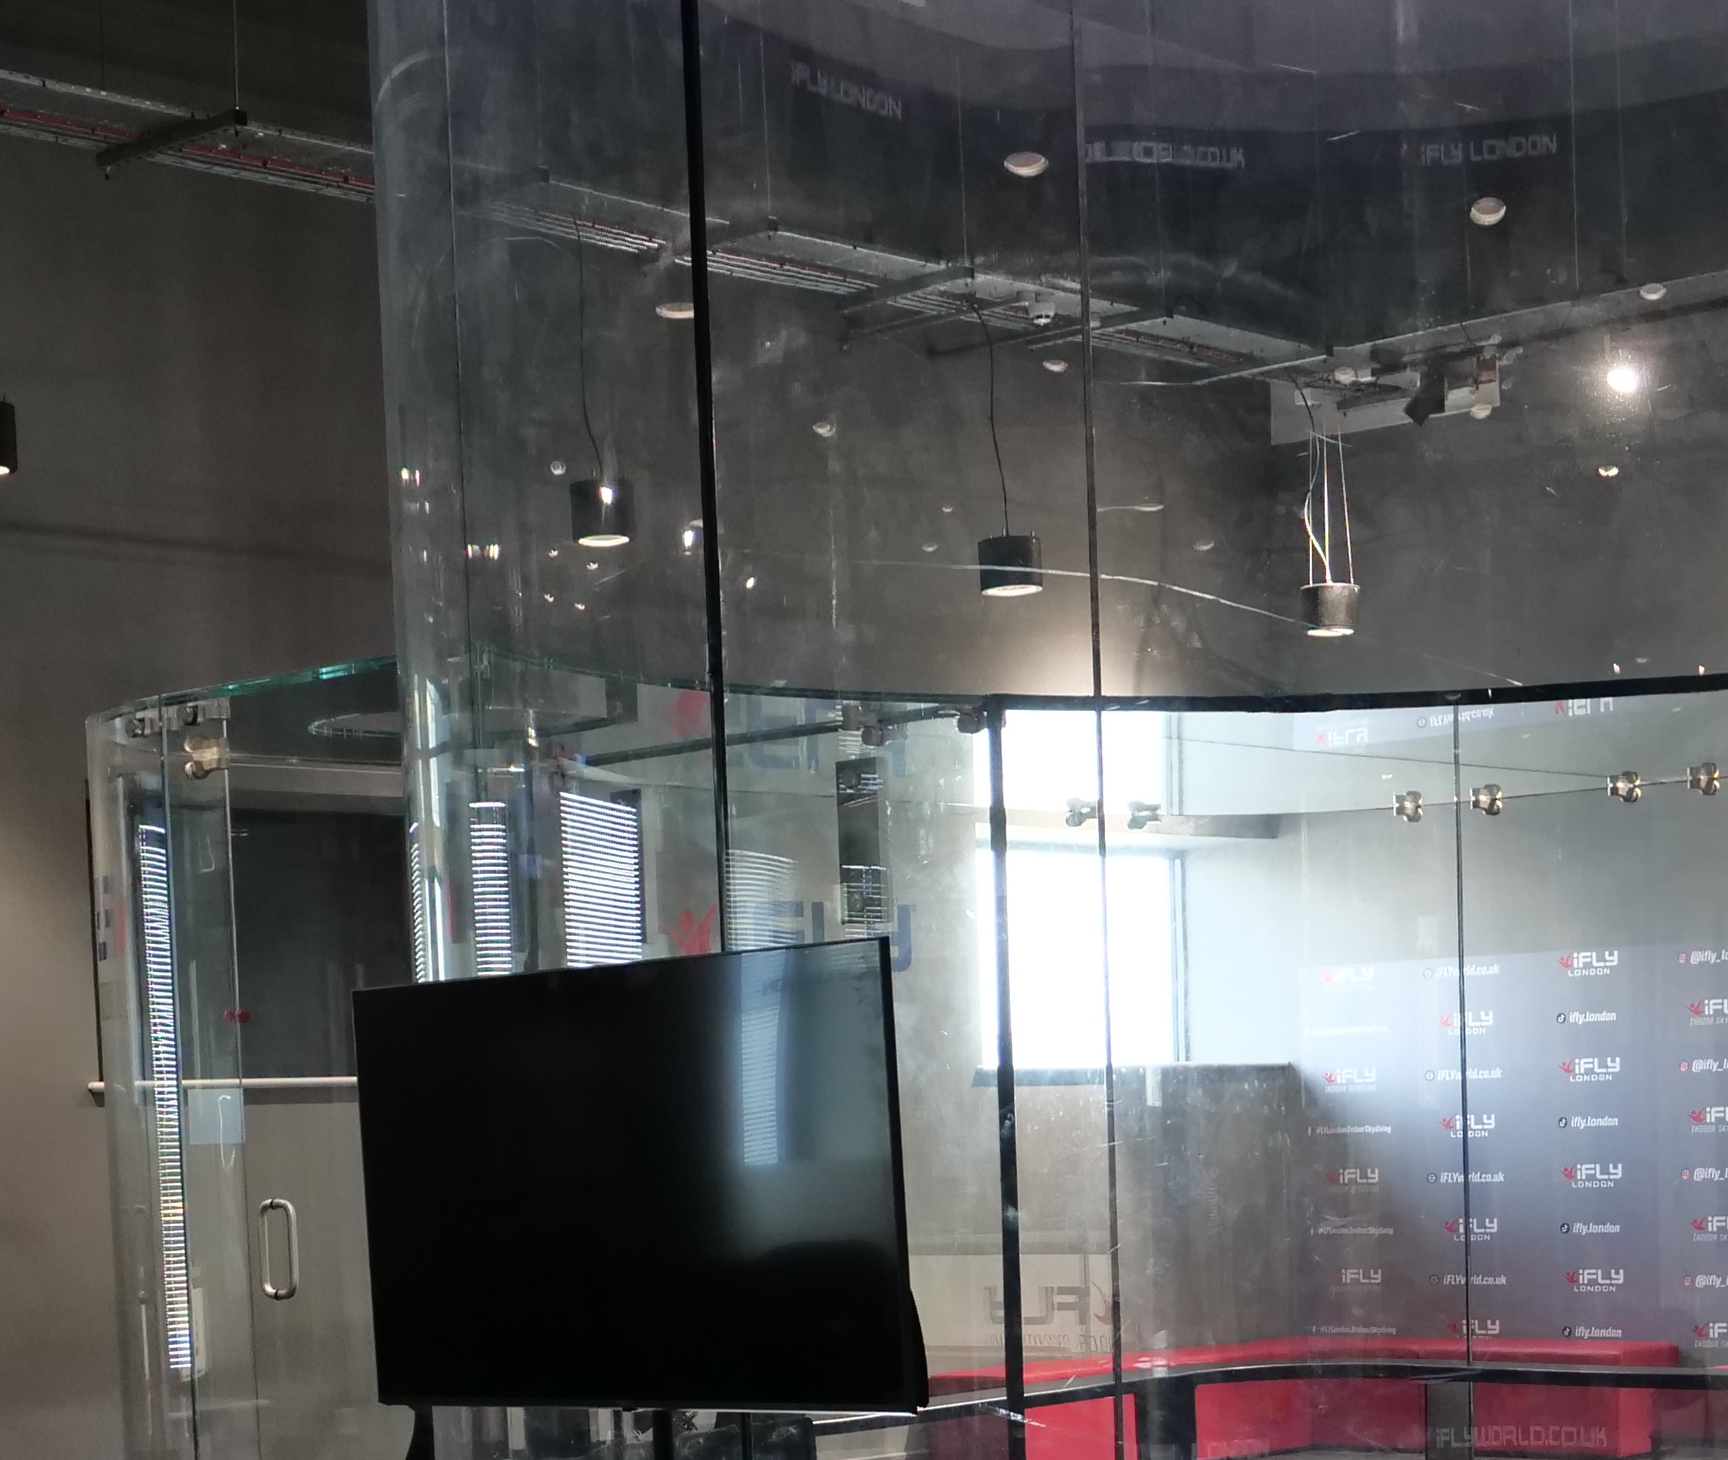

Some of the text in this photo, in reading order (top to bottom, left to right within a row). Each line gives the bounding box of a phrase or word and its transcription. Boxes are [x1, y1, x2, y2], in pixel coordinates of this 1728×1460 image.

[1573, 950, 1618, 968] iFLY
[1435, 964, 1500, 978] iFLYwrld.co.uk
[1568, 968, 1610, 977] LONDON
[1569, 1012, 1616, 1024] ifly.london
[1574, 1057, 1620, 1074] iFLY
[1336, 1068, 1376, 1084] iFLY
[1437, 1067, 1502, 1081] iFLYwrld.co.uk
[1570, 1074, 1612, 1082] LONDON
[1571, 1116, 1618, 1129] ifly.london
[1451, 1130, 1488, 1138] LODON
[1339, 1168, 1379, 1184] iFLY
[1440, 1171, 1504, 1184] iFLYwrld.co.uk
[1577, 1163, 1622, 1179] iFLY
[1572, 1180, 1614, 1188] LONDON
[1573, 1223, 1620, 1235] ifly.london
[1341, 1269, 1381, 1284] iFLY
[1443, 1274, 1507, 1285] iFLYwrld.co.uk
[1579, 1269, 1624, 1284] iFLY
[1575, 1326, 1622, 1339] ifly.london
